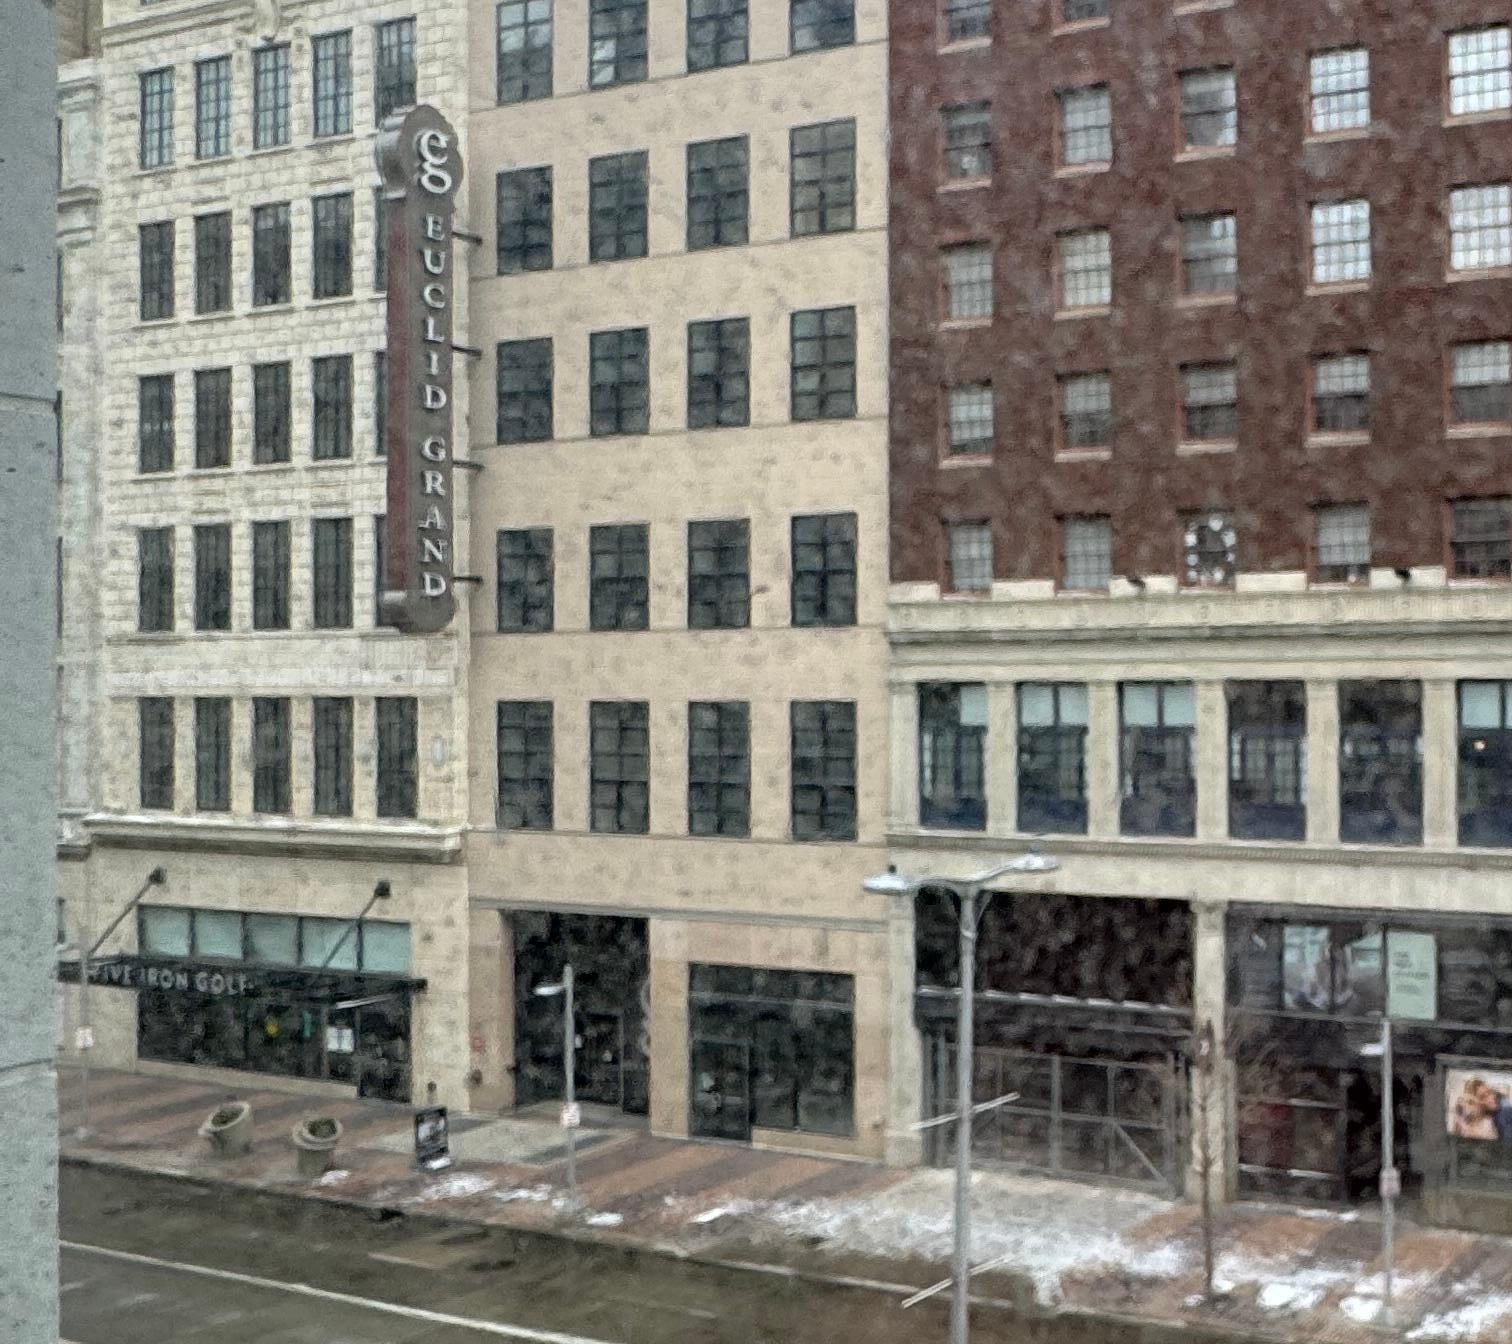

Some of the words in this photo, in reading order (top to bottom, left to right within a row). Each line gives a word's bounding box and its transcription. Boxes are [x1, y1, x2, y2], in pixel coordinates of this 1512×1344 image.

[421, 214, 449, 411] EUCLID
[418, 435, 449, 598] GRAND
[140, 967, 189, 990] IRON
[195, 970, 249, 995] GOLF
